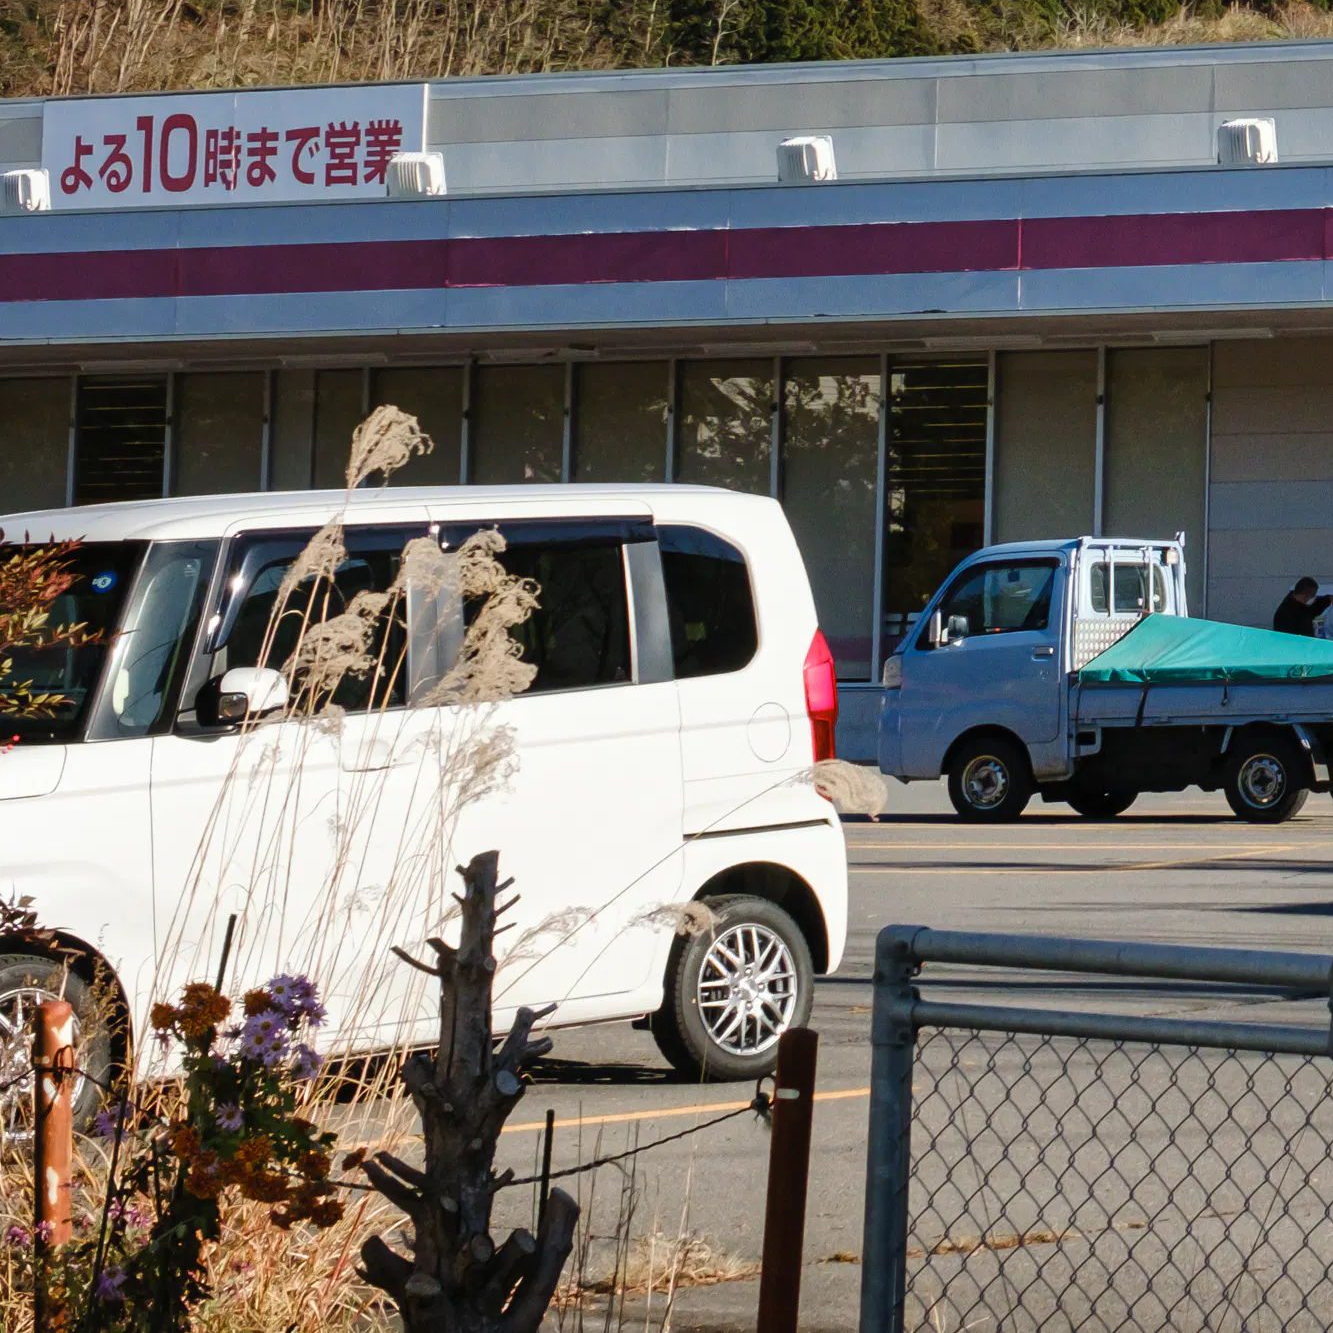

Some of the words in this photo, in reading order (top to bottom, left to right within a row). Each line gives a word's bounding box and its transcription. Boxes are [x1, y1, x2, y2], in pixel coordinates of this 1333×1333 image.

[60, 113, 403, 195] よる10時まで営業
